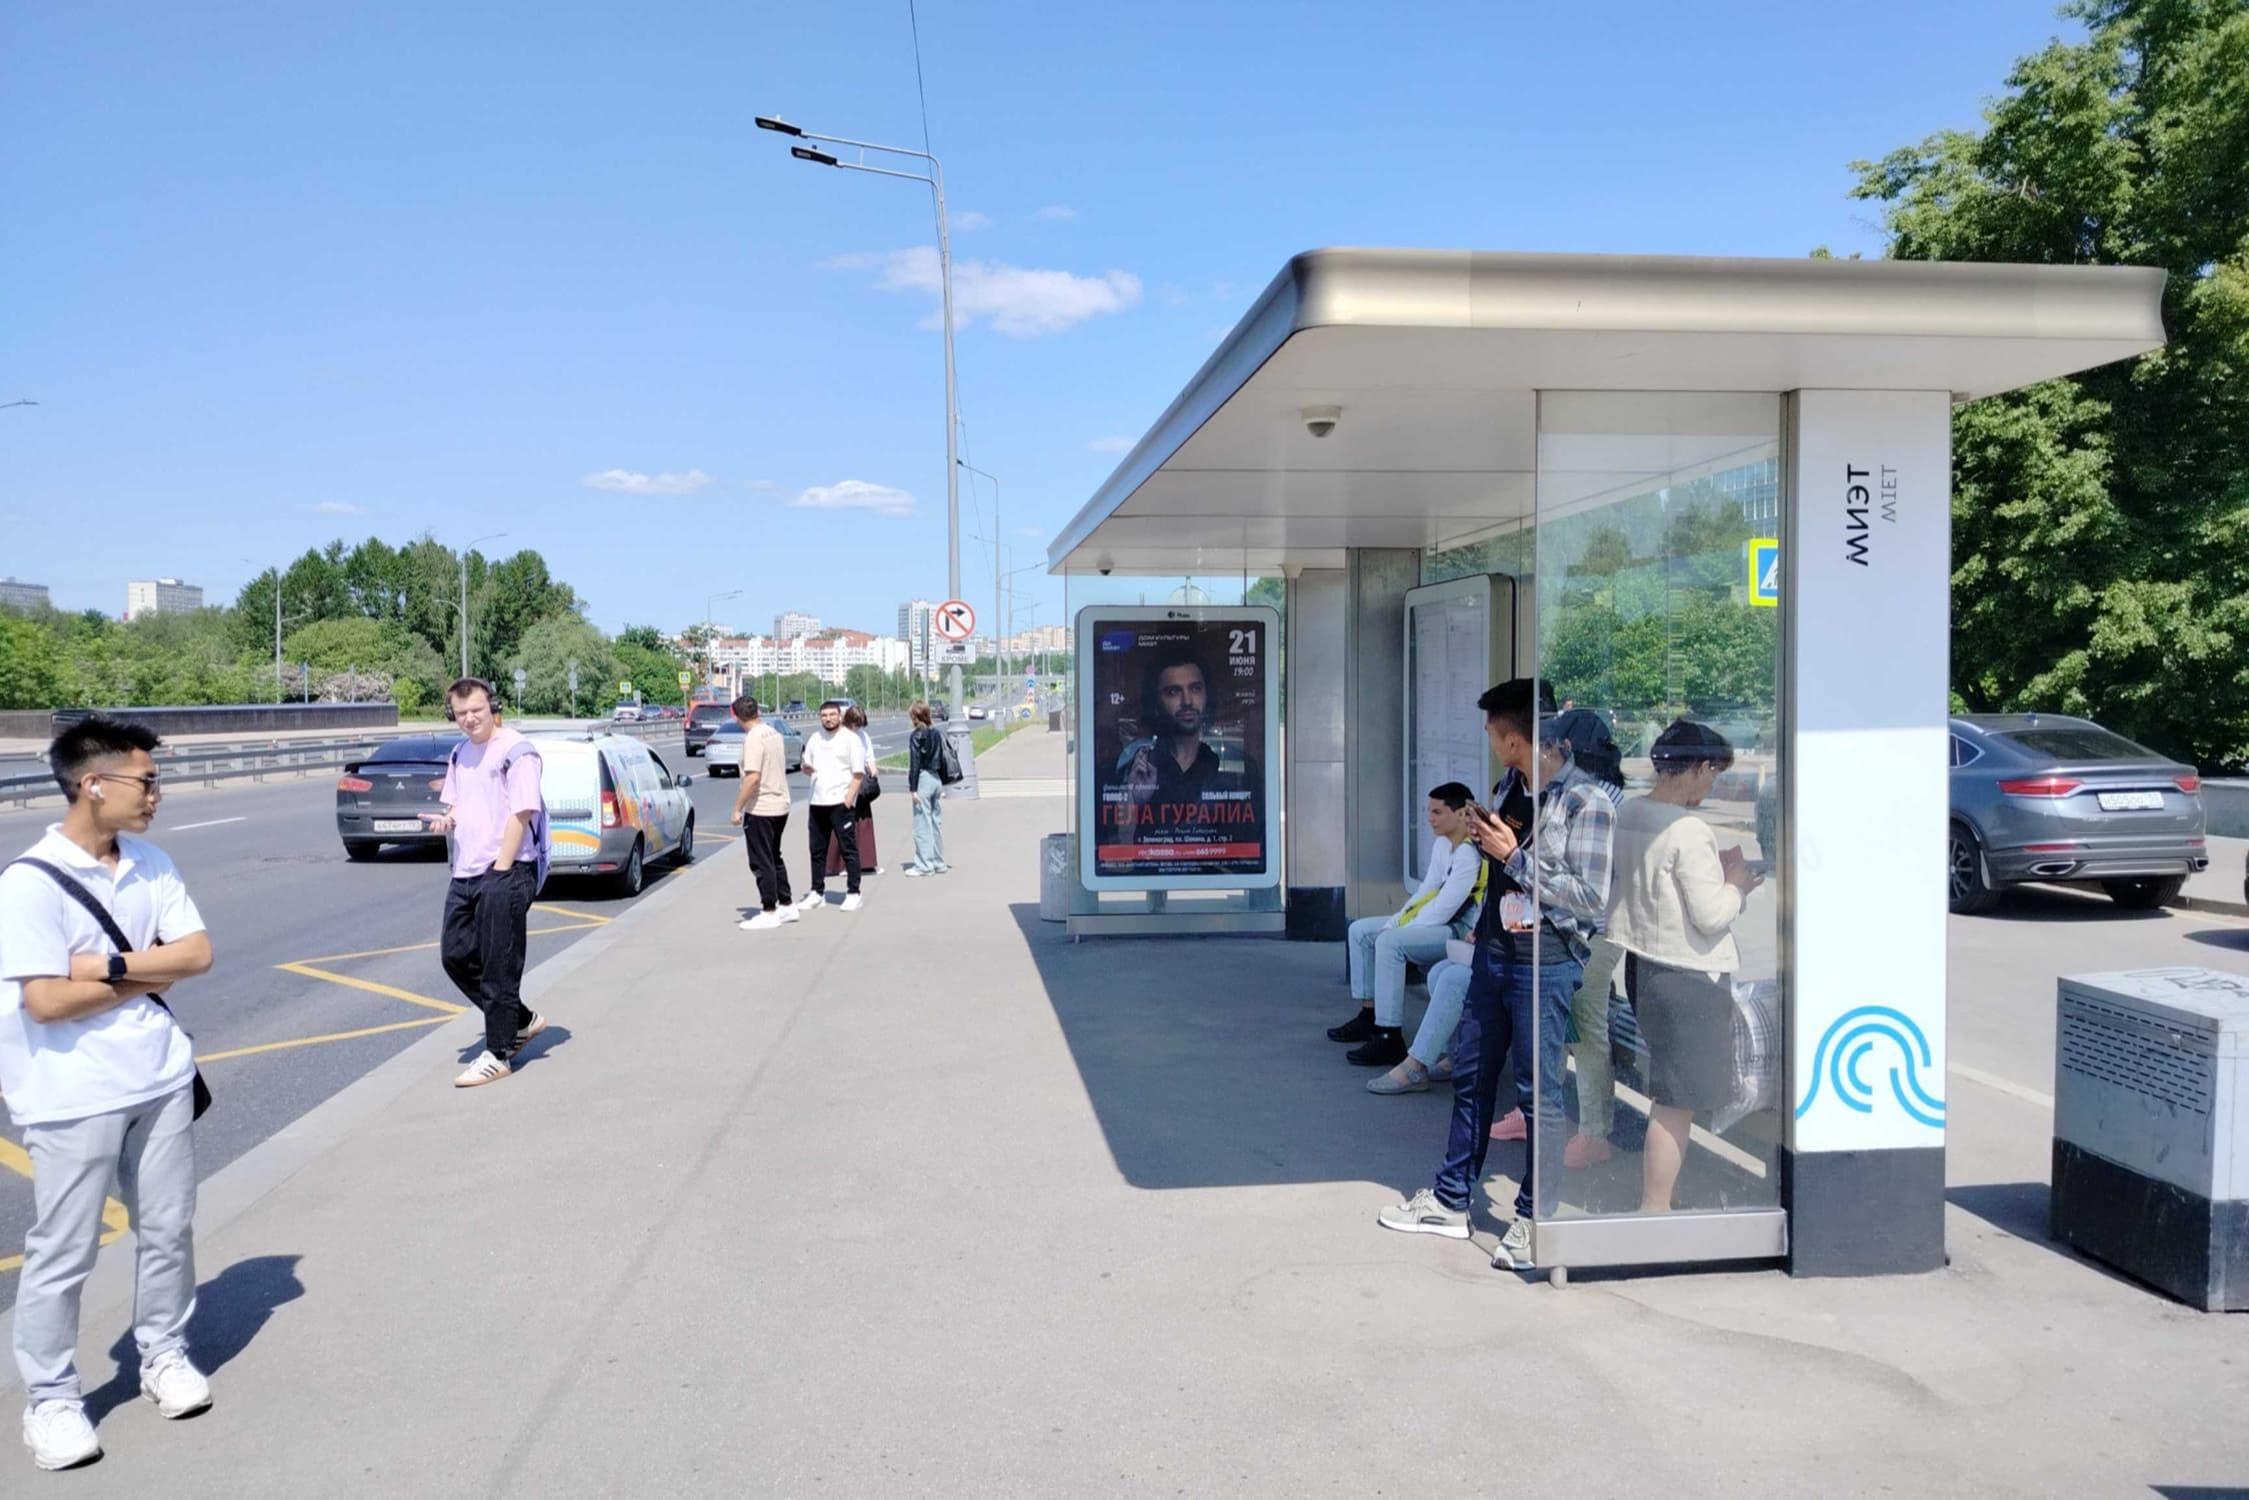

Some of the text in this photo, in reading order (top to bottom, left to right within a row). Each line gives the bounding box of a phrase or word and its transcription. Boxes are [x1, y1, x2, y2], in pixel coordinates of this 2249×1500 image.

[1881, 464, 1897, 523] MIET
[1846, 464, 1869, 566] МИЭТ
[1229, 629, 1256, 654] 21
[1233, 667, 1254, 677] 19:00
[1110, 692, 1125, 704] 12+
[1102, 802, 1255, 825] ГЕЛА ГУРАЛИА
